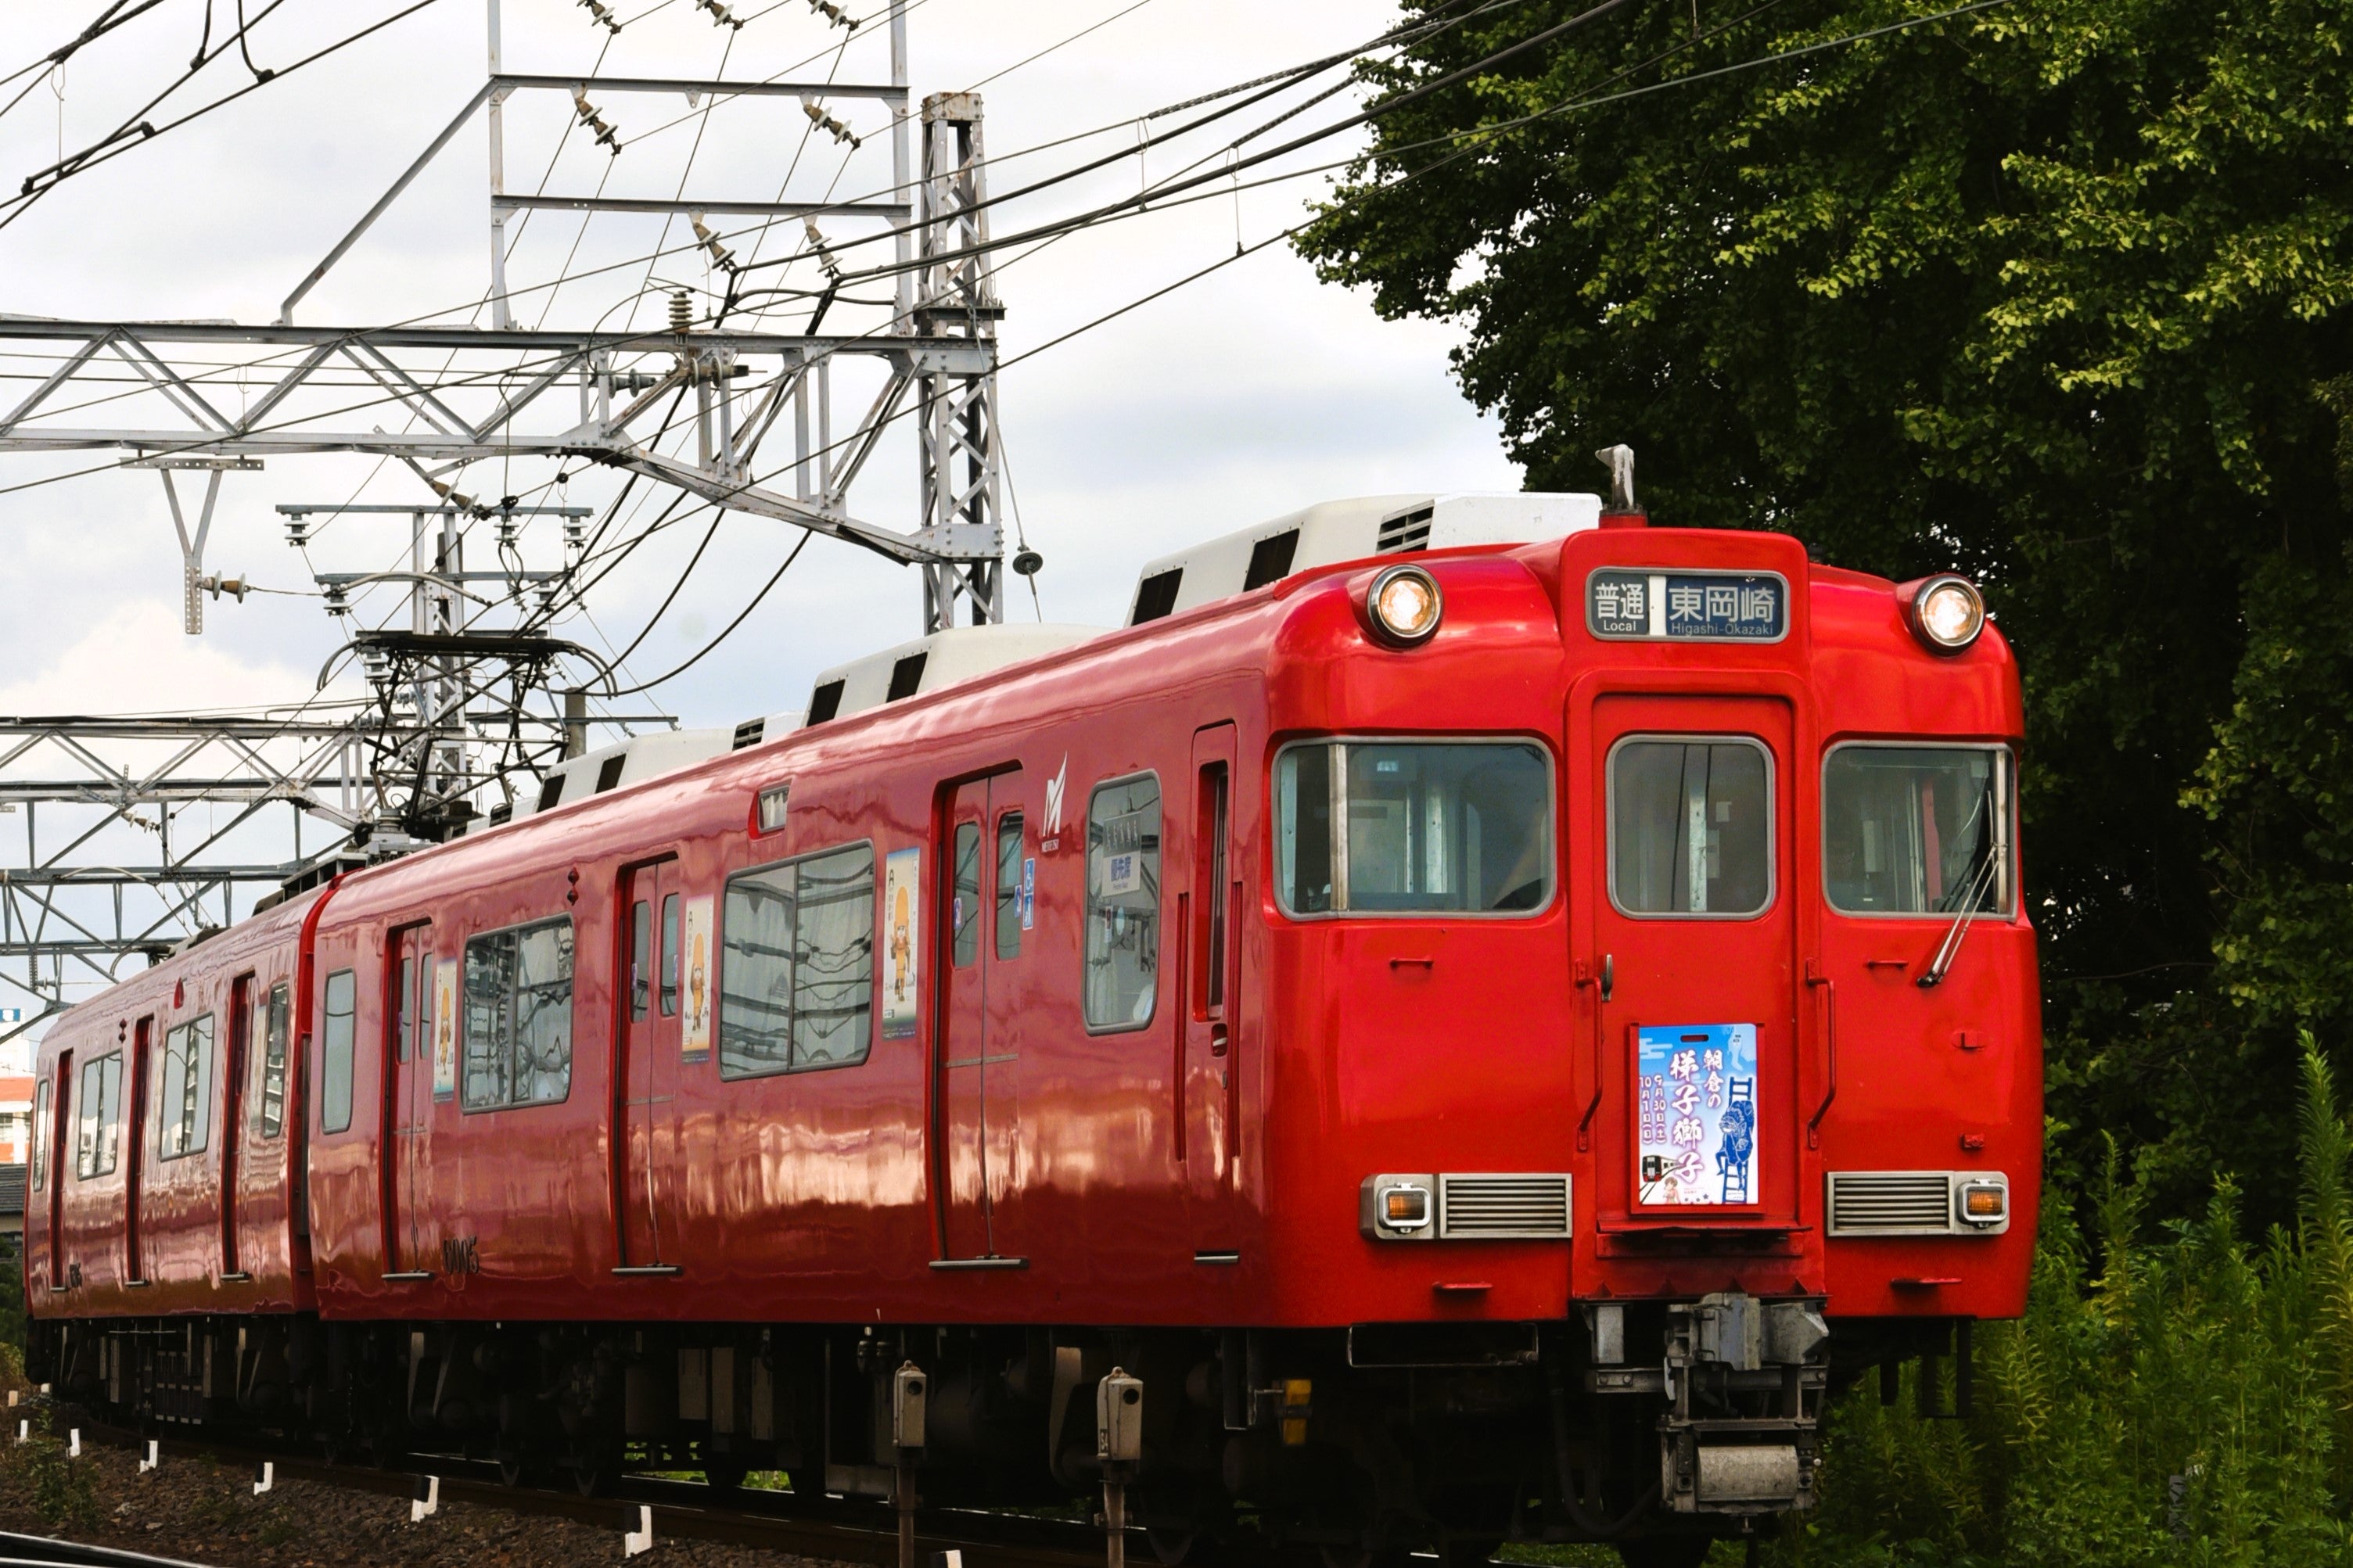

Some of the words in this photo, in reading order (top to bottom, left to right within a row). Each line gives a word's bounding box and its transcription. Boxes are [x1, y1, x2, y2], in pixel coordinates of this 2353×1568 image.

[1595, 583, 1644, 619] 普通
[1669, 586, 1775, 623] 東岡崎
[1604, 619, 1636, 631] Local
[1672, 623, 1773, 636] Higashi-Okazaki
[1703, 1049, 1724, 1107] 朝倉の
[1669, 1050, 1704, 1183] 梯子獅子
